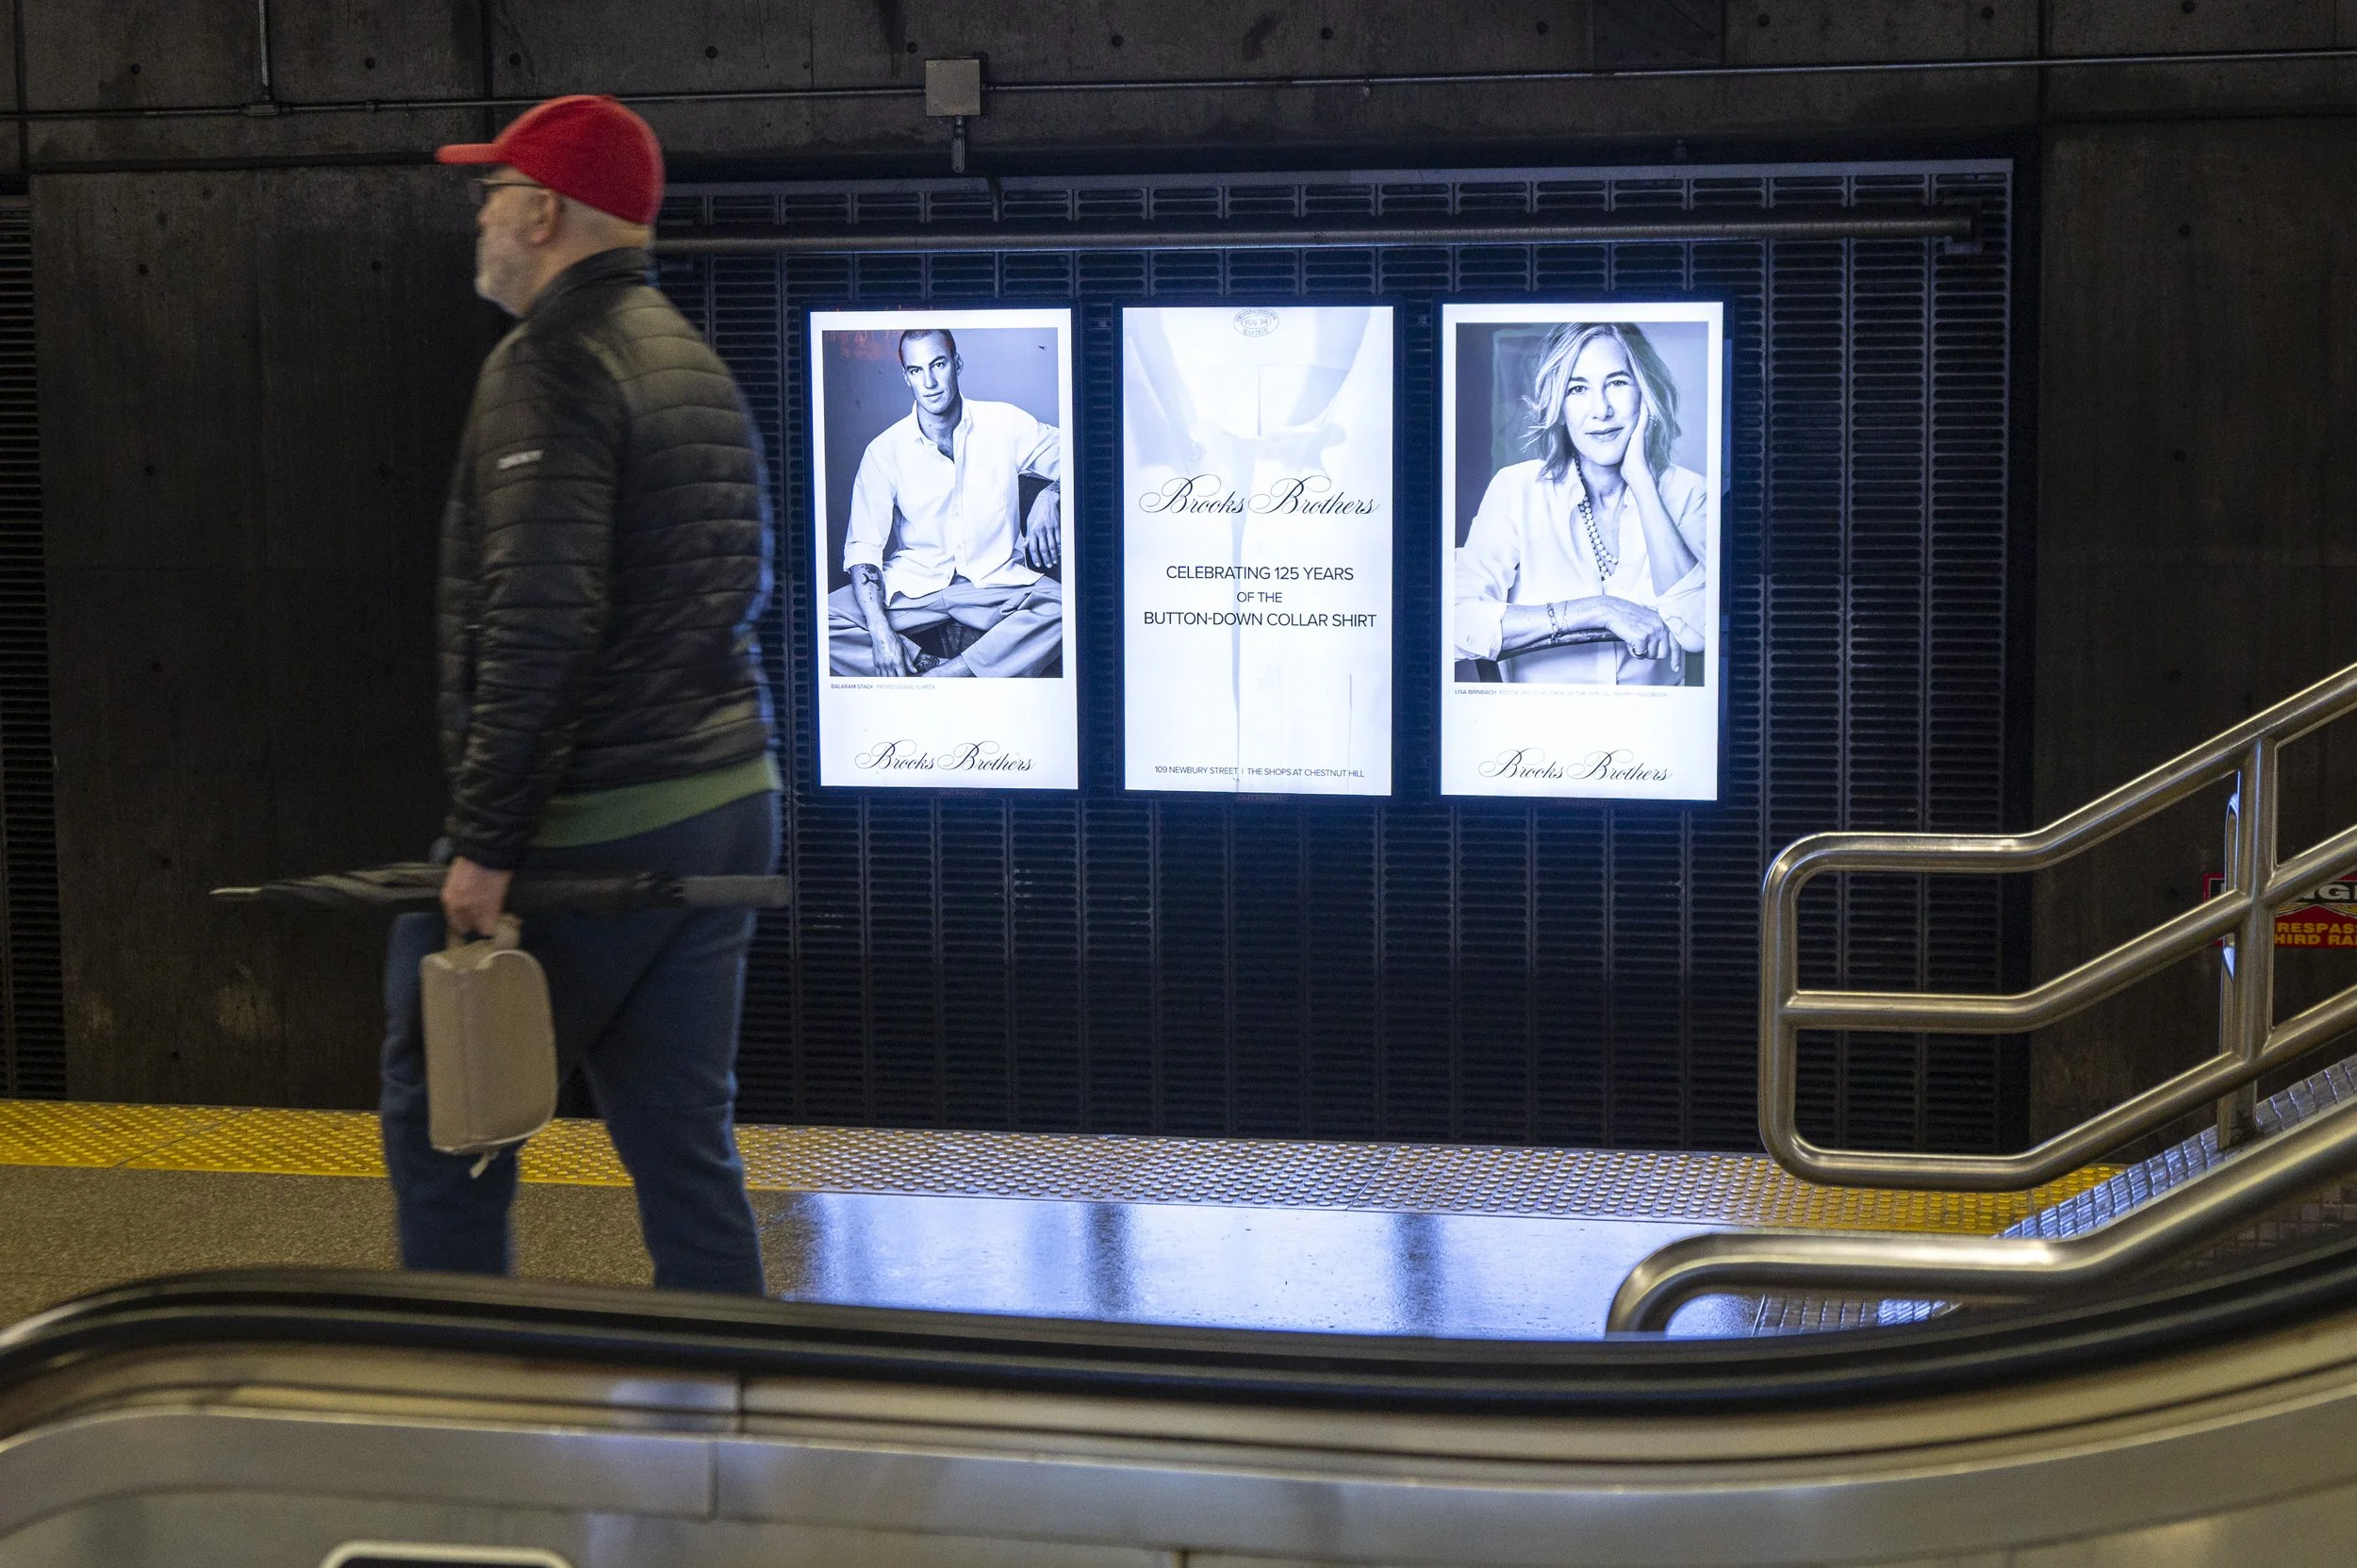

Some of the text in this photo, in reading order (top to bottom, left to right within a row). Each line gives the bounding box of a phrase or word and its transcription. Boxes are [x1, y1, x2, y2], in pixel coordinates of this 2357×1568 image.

[1139, 474, 1380, 515] Brooks Brothers
[1166, 566, 1354, 581] CELEBRATING 125 YEARS
[1236, 592, 1283, 603] OF THE
[1144, 611, 1376, 628] BUTTON-DOWN COLLAR SHIRT
[854, 739, 1037, 771] Brooks Brothers
[1478, 747, 1673, 782] Brooks Brothers
[1210, 767, 1238, 775] STREET
[1264, 767, 1292, 776] SHOPS
[1304, 768, 1347, 777] CHESTNUT
[1348, 769, 1364, 778] HILL
[2276, 922, 2357, 933] RESPAS
[2275, 933, 2321, 945] HIRD
